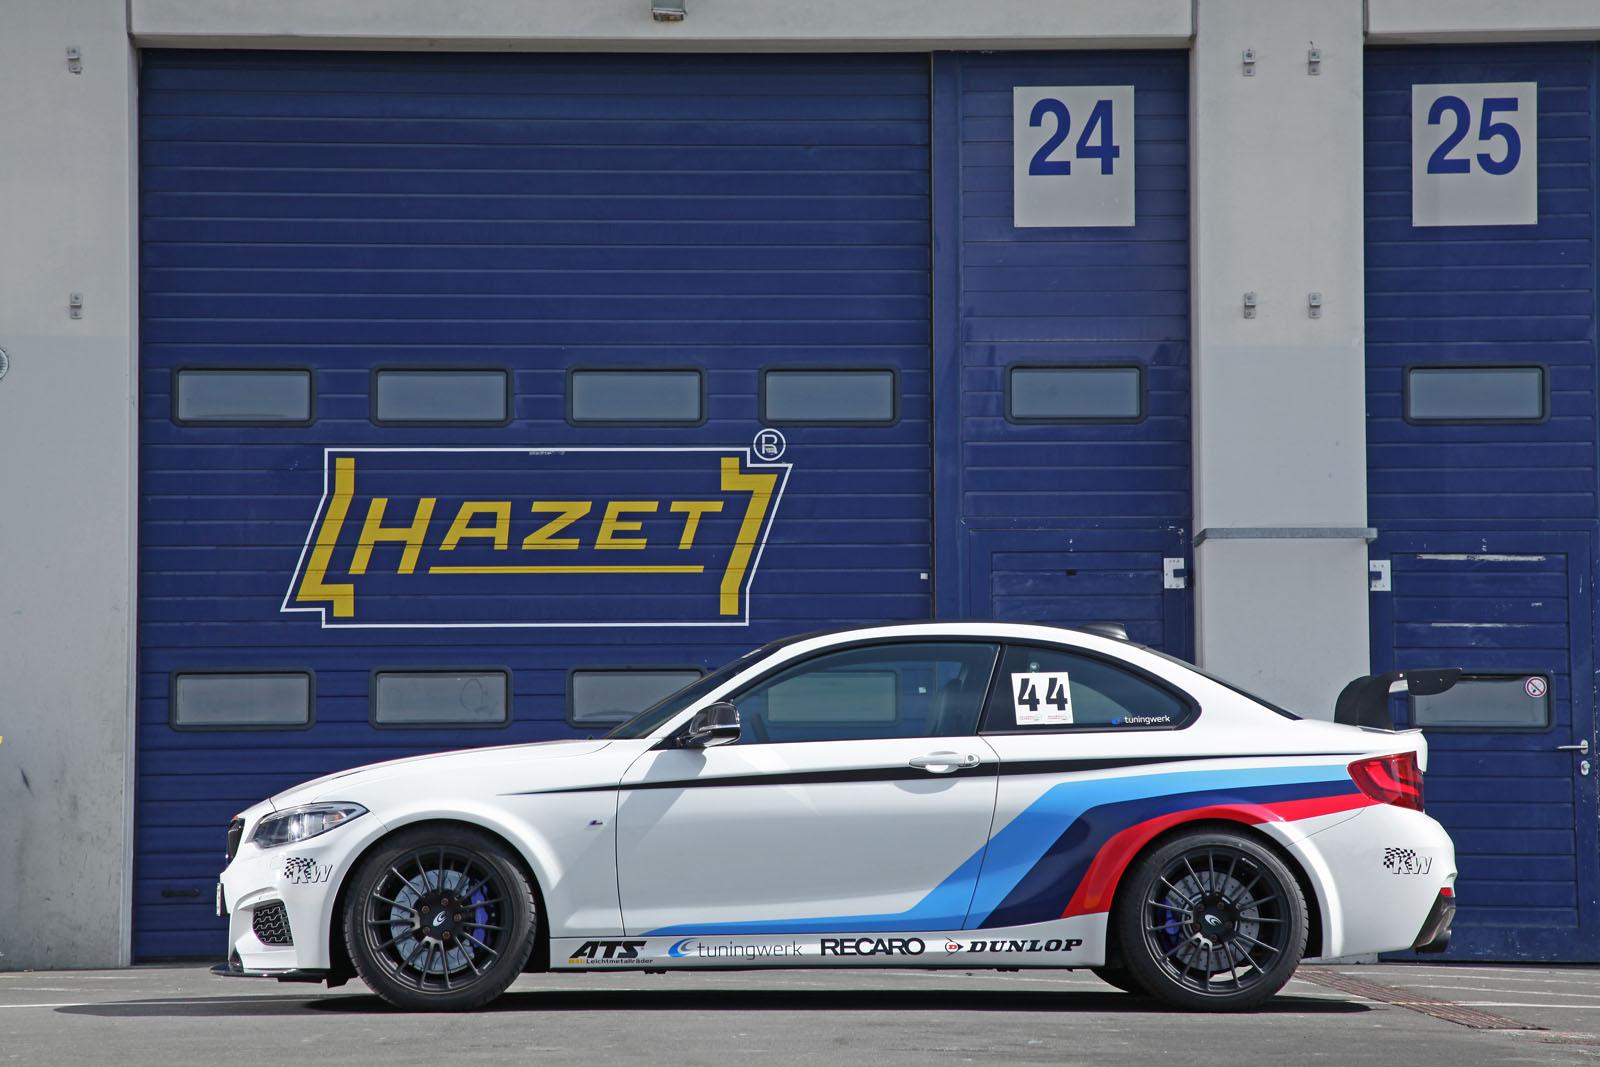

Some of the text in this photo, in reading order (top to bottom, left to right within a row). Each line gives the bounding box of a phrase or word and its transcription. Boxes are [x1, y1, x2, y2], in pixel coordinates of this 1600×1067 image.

[1029, 98, 1120, 176] 24
[1427, 95, 1521, 175] 25
[348, 497, 725, 575] HAZET
[1018, 677, 1068, 712] 44
[1124, 714, 1171, 725] tuningwerk
[291, 864, 333, 885] KW
[1392, 856, 1432, 875] KW
[569, 940, 648, 958] ATS
[697, 941, 803, 960] tuningwerk
[820, 937, 926, 956] RECARO
[967, 939, 1083, 953] DUNLOP
